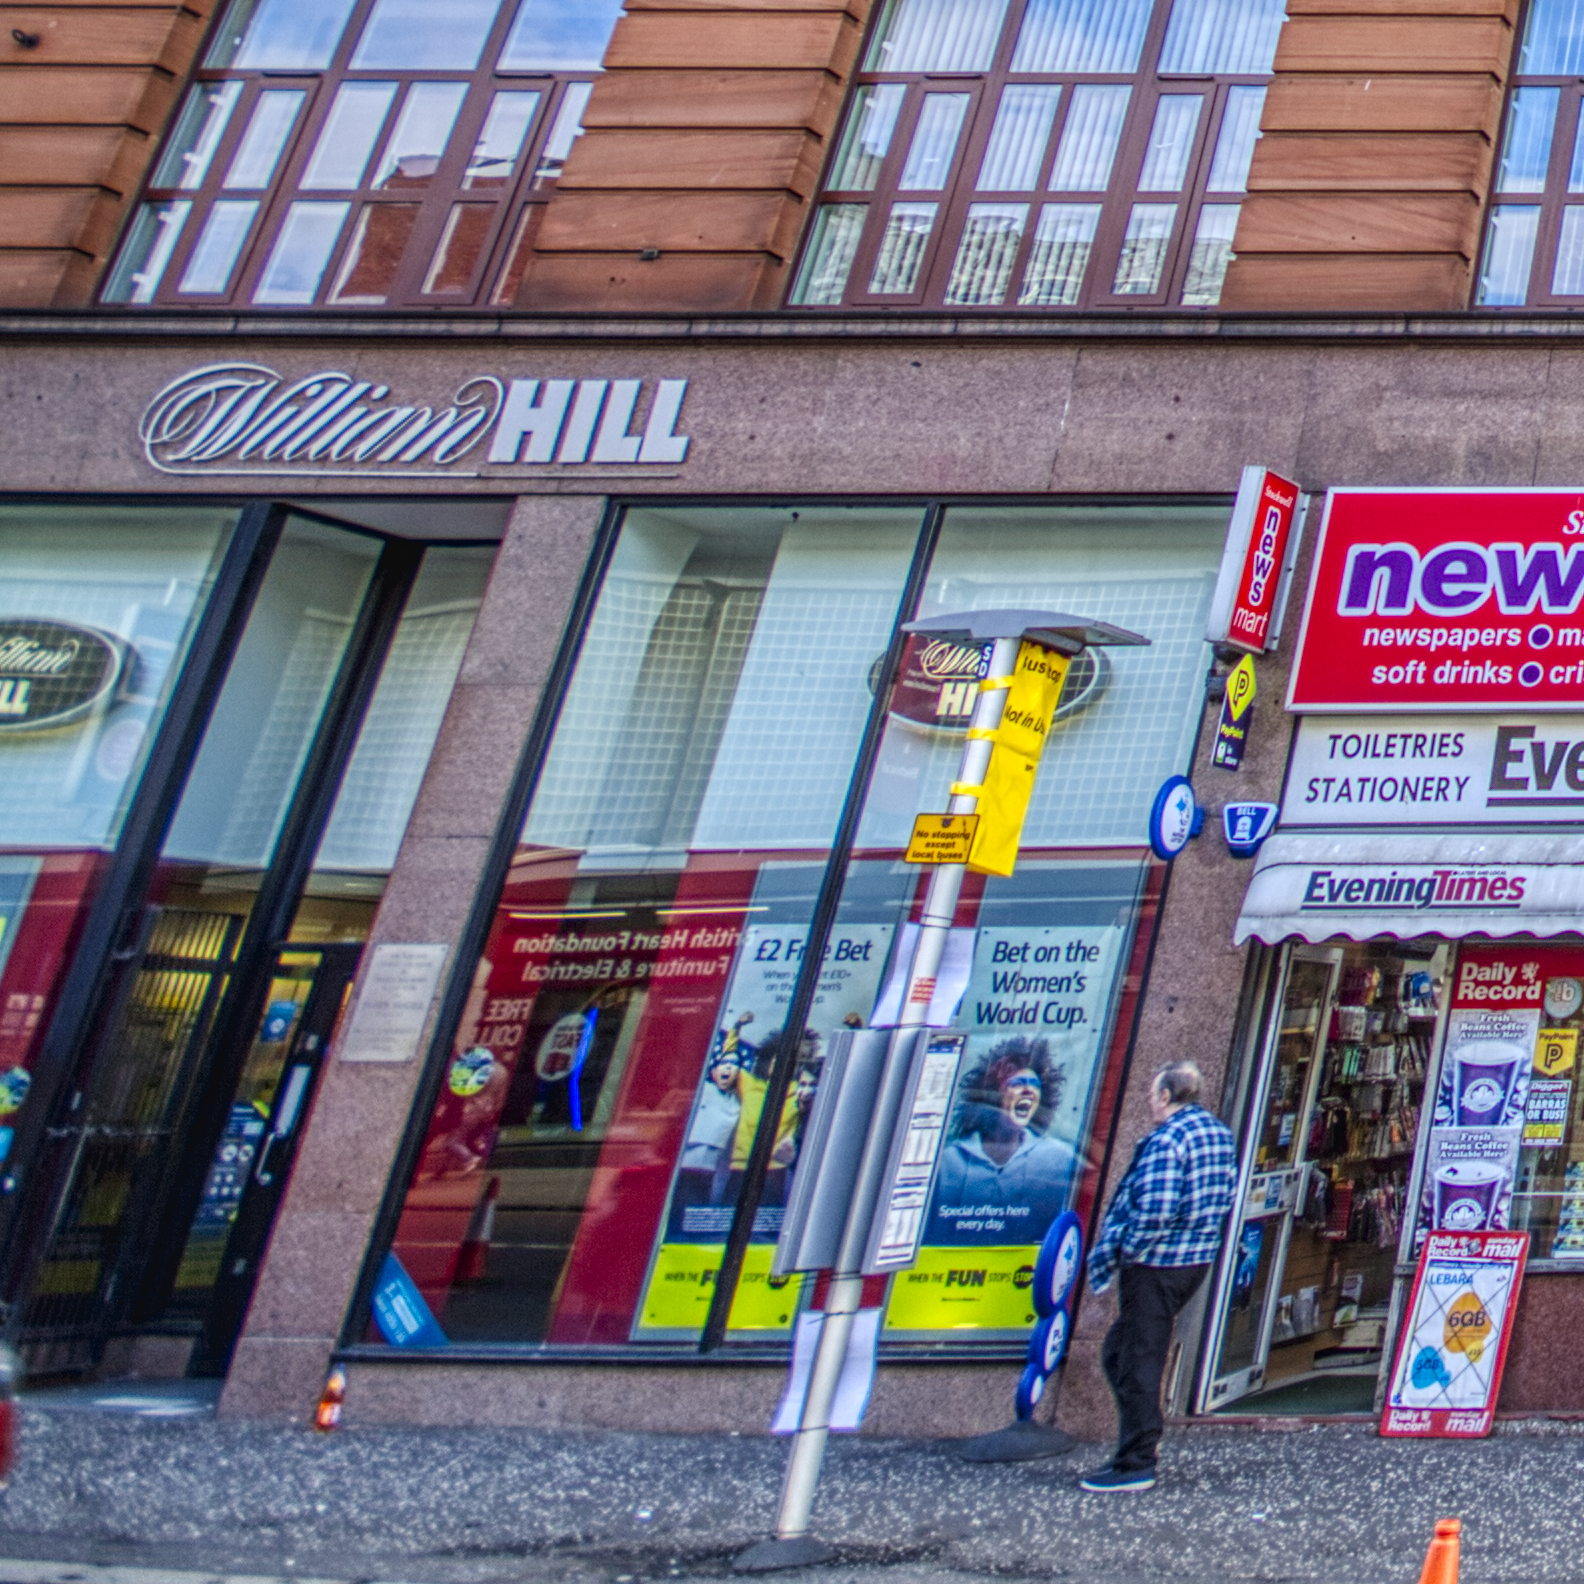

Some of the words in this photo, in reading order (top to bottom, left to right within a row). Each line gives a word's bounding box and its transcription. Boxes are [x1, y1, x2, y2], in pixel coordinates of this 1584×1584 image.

[139, 362, 504, 476] William
[488, 379, 690, 464] HILL
[1363, 623, 1522, 651] newspapers
[1371, 661, 1426, 685] soft
[1433, 660, 1514, 685] drinks
[1327, 733, 1465, 759] TOILETRIES
[1305, 776, 1472, 804] STATIONERY
[754, 939, 782, 961] £2
[834, 939, 873, 961] Bet
[992, 941, 1031, 963] Bet
[1034, 945, 1061, 963] on
[1065, 939, 1100, 963] the
[992, 970, 1088, 994] Women's
[1461, 962, 1518, 984] Daily
[1457, 980, 1542, 1001] Record
[976, 1001, 1040, 1024] World
[1042, 1001, 1088, 1029] Cup.
[939, 1204, 975, 1218] Special
[975, 1204, 1005, 1217] offers
[1006, 1204, 1031, 1216] here
[956, 1220, 985, 1231] every
[1427, 1246, 1468, 1257] Record
[1482, 1238, 1526, 1258] mail
[1429, 1236, 1457, 1249] Daily
[945, 1269, 988, 1287] FUN
[1429, 1273, 1475, 1285] LEBARA
[1388, 1421, 1431, 1432] Record
[1445, 1411, 1490, 1433] mail
[1391, 1411, 1420, 1423] Daily
